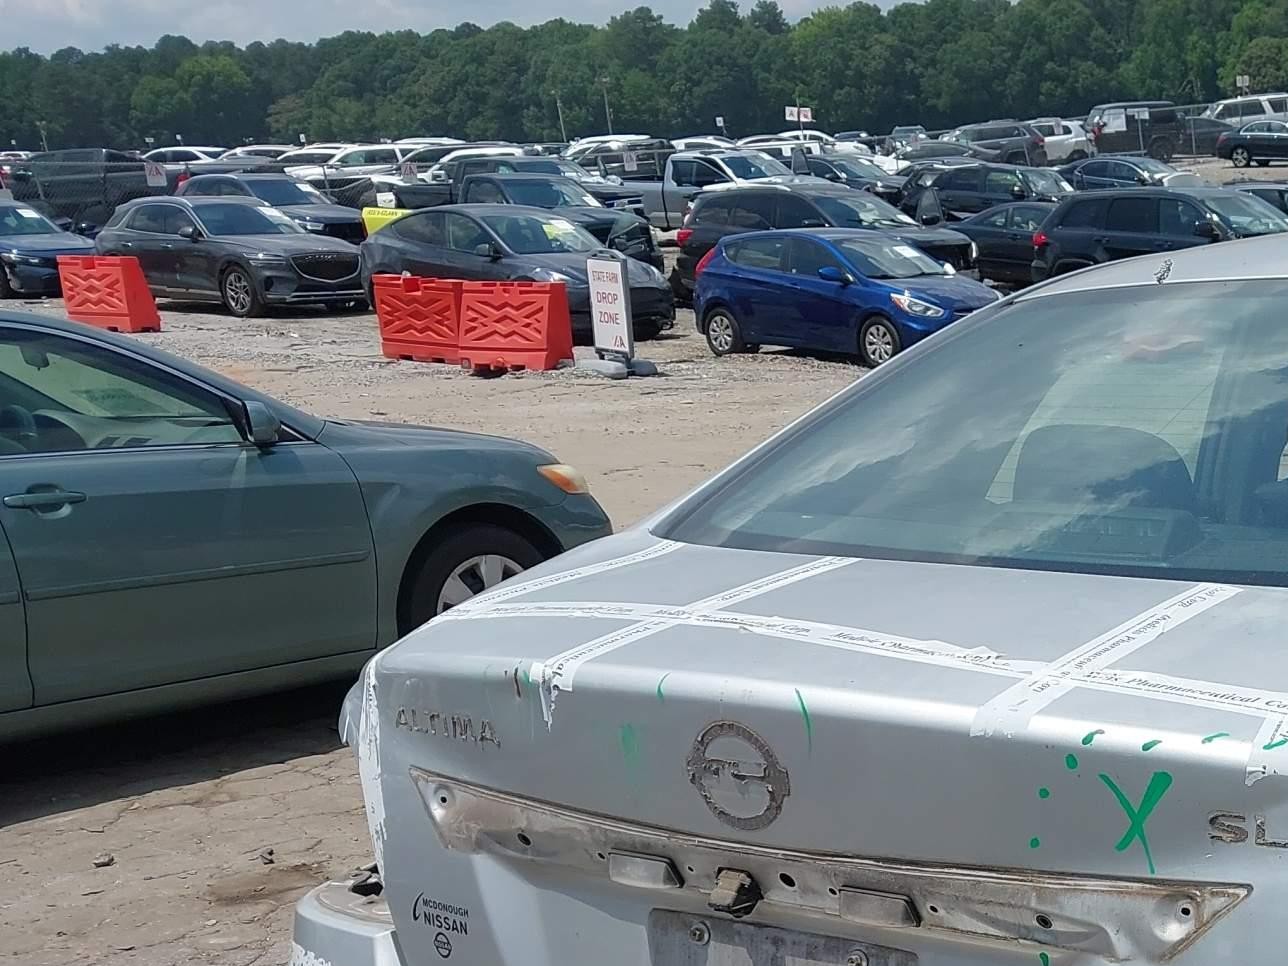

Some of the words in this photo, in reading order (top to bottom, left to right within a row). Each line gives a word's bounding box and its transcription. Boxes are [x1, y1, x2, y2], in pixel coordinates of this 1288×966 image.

[596, 291, 618, 305] DROP
[599, 311, 620, 325] ZONE
[1126, 677, 1263, 704] Pharmaceutical
[395, 706, 501, 749] ALTIMA
[422, 897, 469, 918] MCDONOUGH
[423, 911, 468, 935] NISSAN
